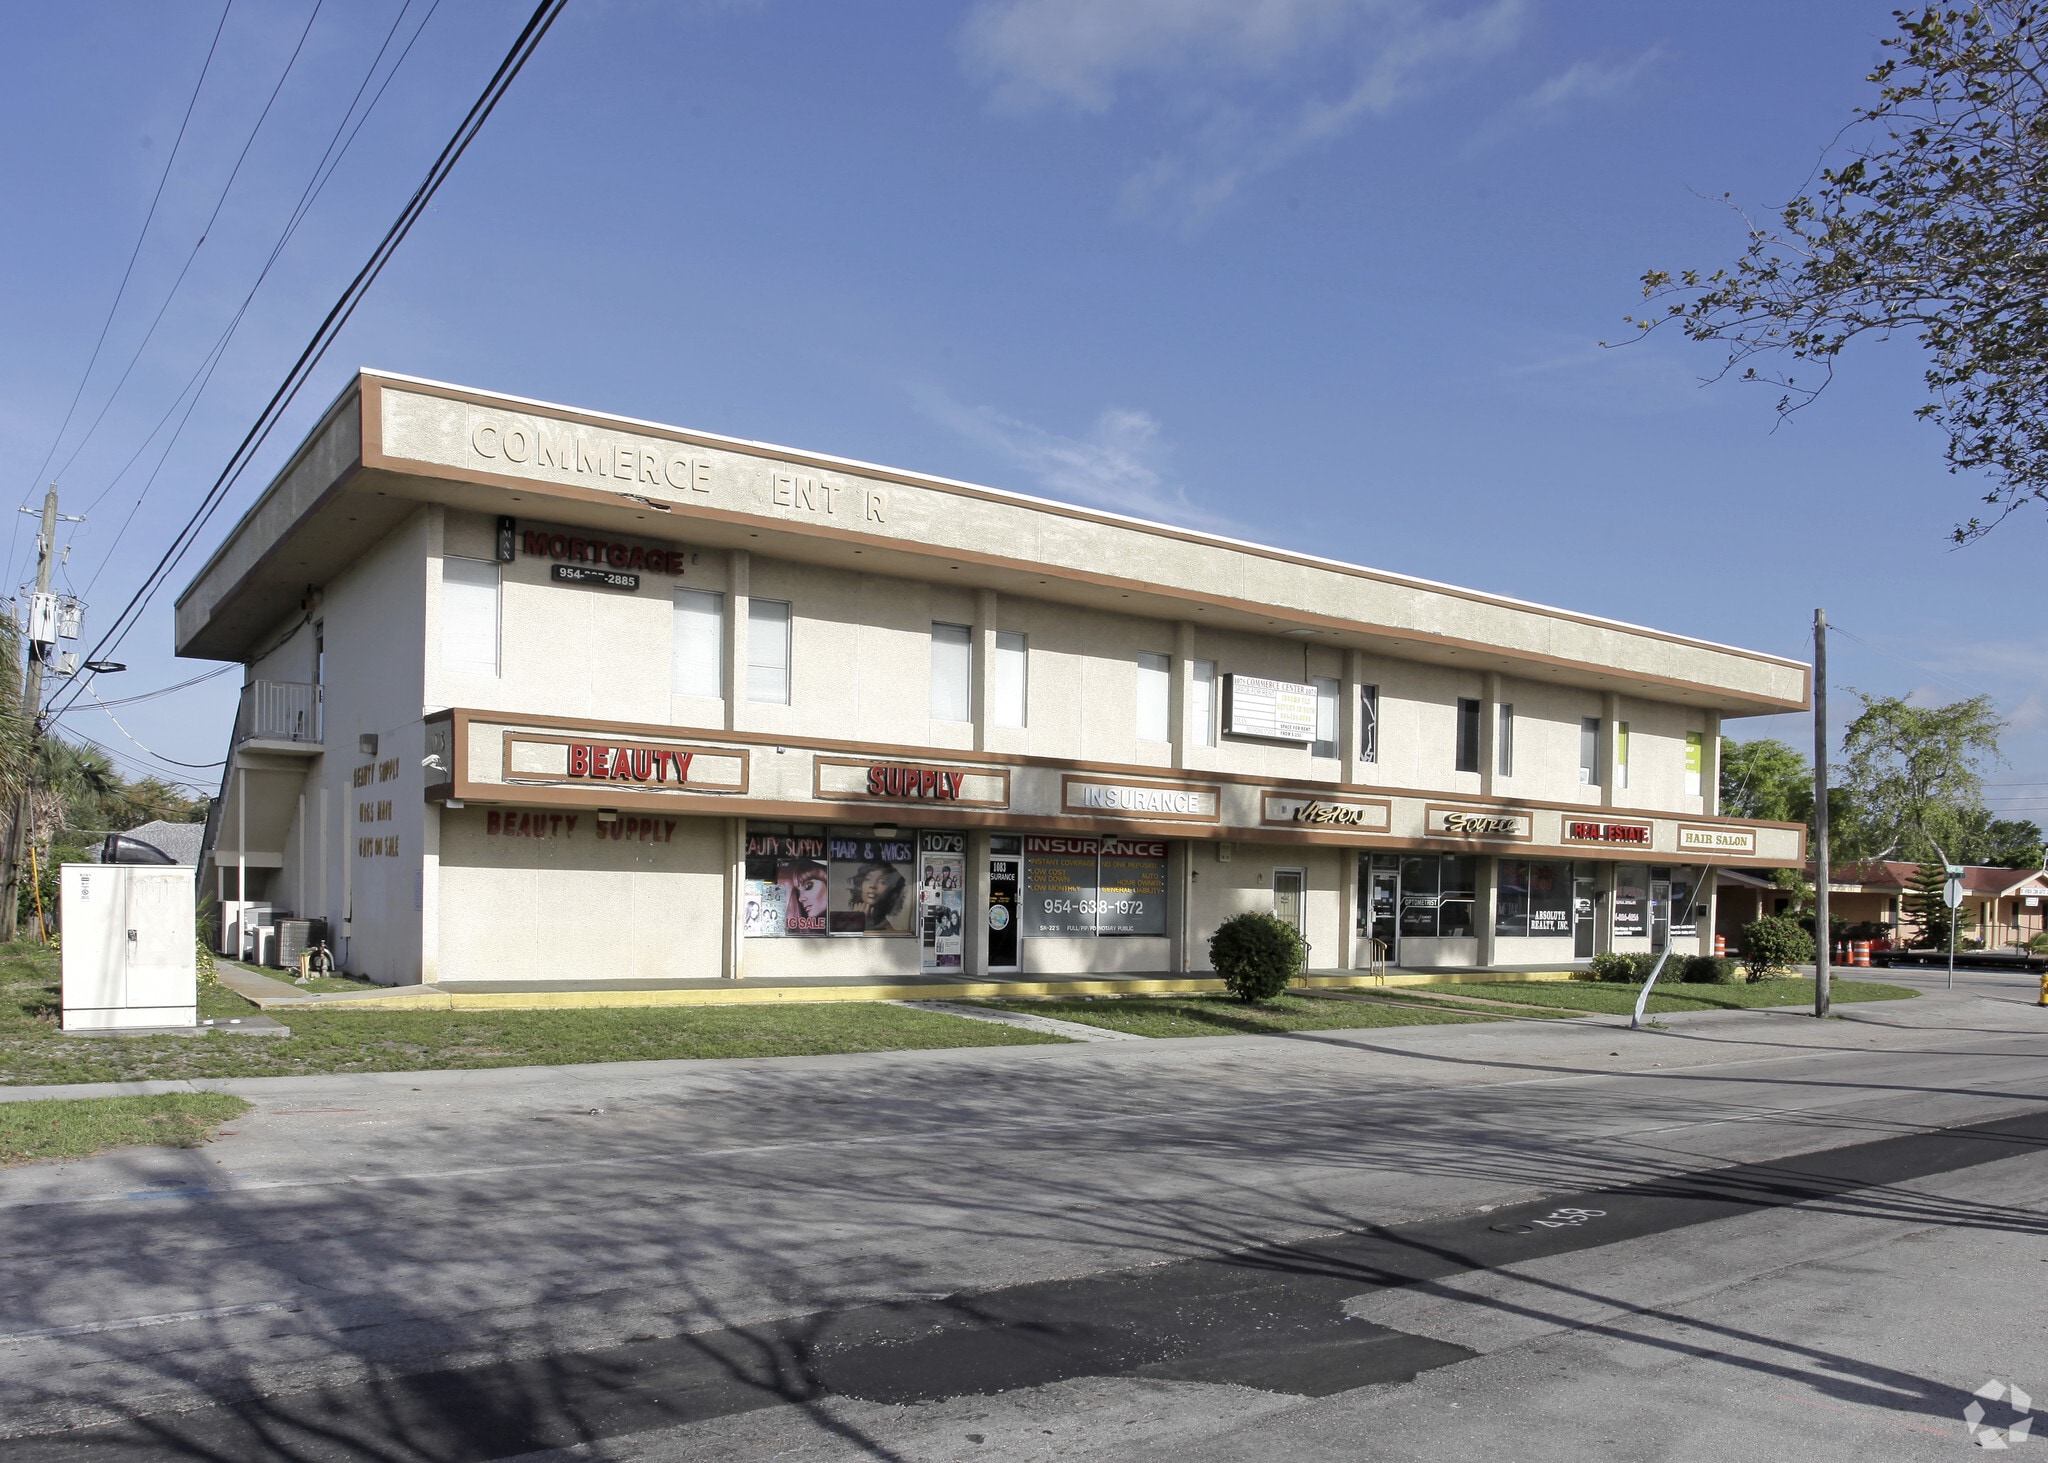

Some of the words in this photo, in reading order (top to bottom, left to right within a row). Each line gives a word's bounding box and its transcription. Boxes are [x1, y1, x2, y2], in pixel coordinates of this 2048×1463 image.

[472, 420, 711, 493] COMMERCE
[523, 530, 685, 575] MORTGAGE
[559, 567, 636, 587] 954--2885
[1246, 678, 1280, 690] COMMERCE
[1281, 684, 1305, 693] CENTER
[379, 758, 400, 783] SUPPLY
[568, 744, 694, 783] BEAUTY
[868, 766, 965, 799] SUPPLY
[1083, 787, 1199, 813] INSURANCE
[487, 811, 579, 839] BEAUTY
[596, 817, 677, 843] SUPPLY
[1573, 823, 1605, 839] REAL
[1606, 825, 1650, 843] ESTATE
[785, 838, 824, 857] SUPPLY
[923, 835, 964, 851] 1079
[1028, 838, 1164, 856] INSURANCE
[1685, 833, 1713, 844] HAIR
[1715, 835, 1748, 846] SALON
[830, 841, 858, 859] HAIR
[864, 843, 874, 860] &
[879, 842, 912, 862] WIGS
[993, 862, 1006, 873] 1083
[1060, 859, 1097, 867] COVERAGE
[1044, 899, 1144, 914] 954-638-1972
[1534, 910, 1566, 920] ABSOLUTE
[798, 917, 826, 929] SALE
[1557, 920, 1569, 930] INC.
